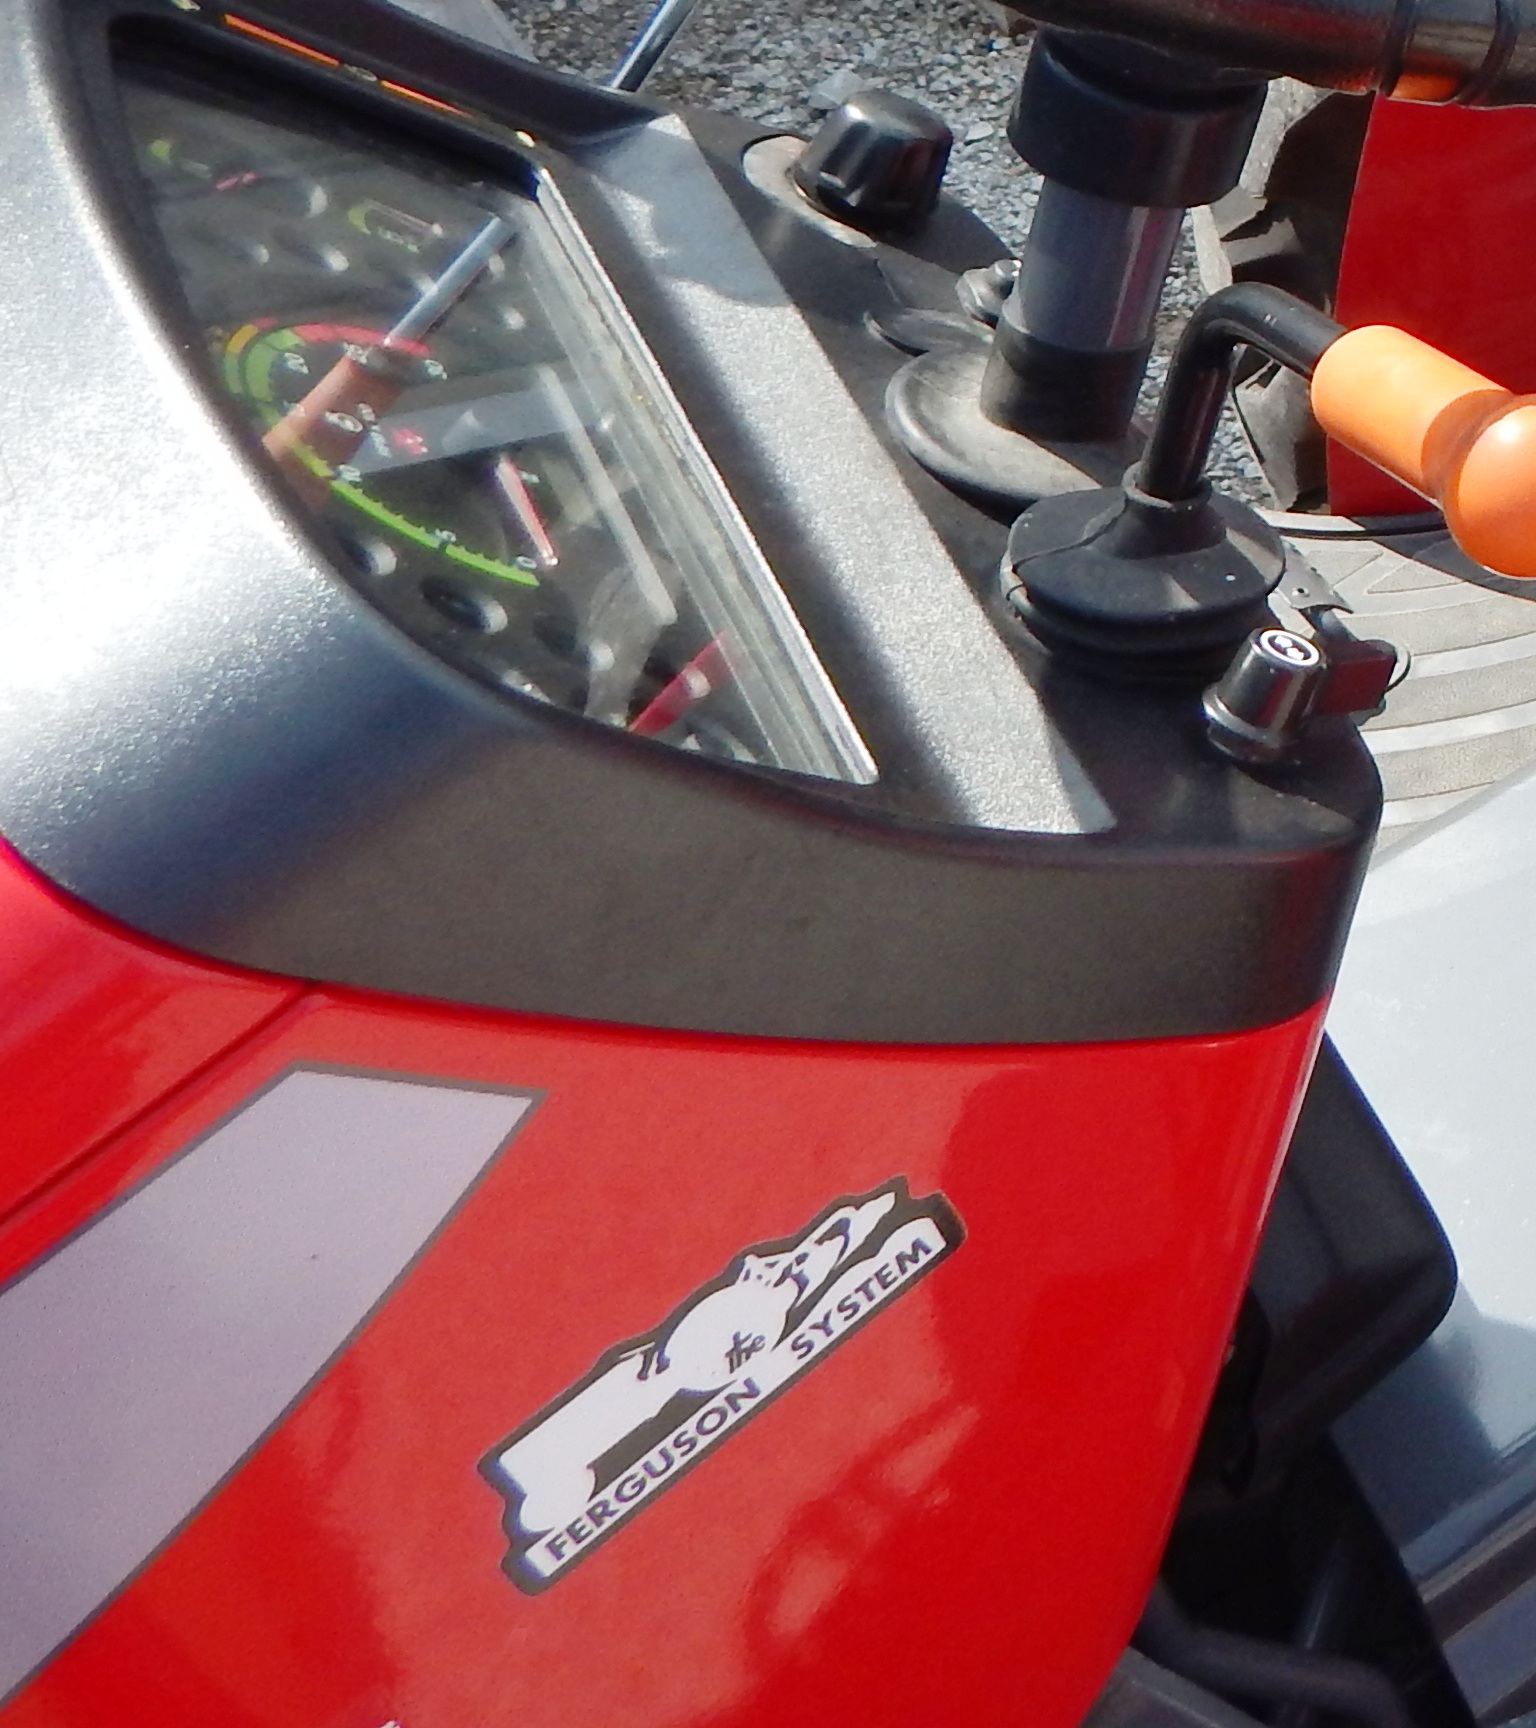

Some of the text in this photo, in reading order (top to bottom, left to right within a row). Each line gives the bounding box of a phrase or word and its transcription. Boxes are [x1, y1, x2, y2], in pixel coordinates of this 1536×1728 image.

[544, 1235, 933, 1563] FERGUSON SYSTEM
[725, 1330, 766, 1375] the
